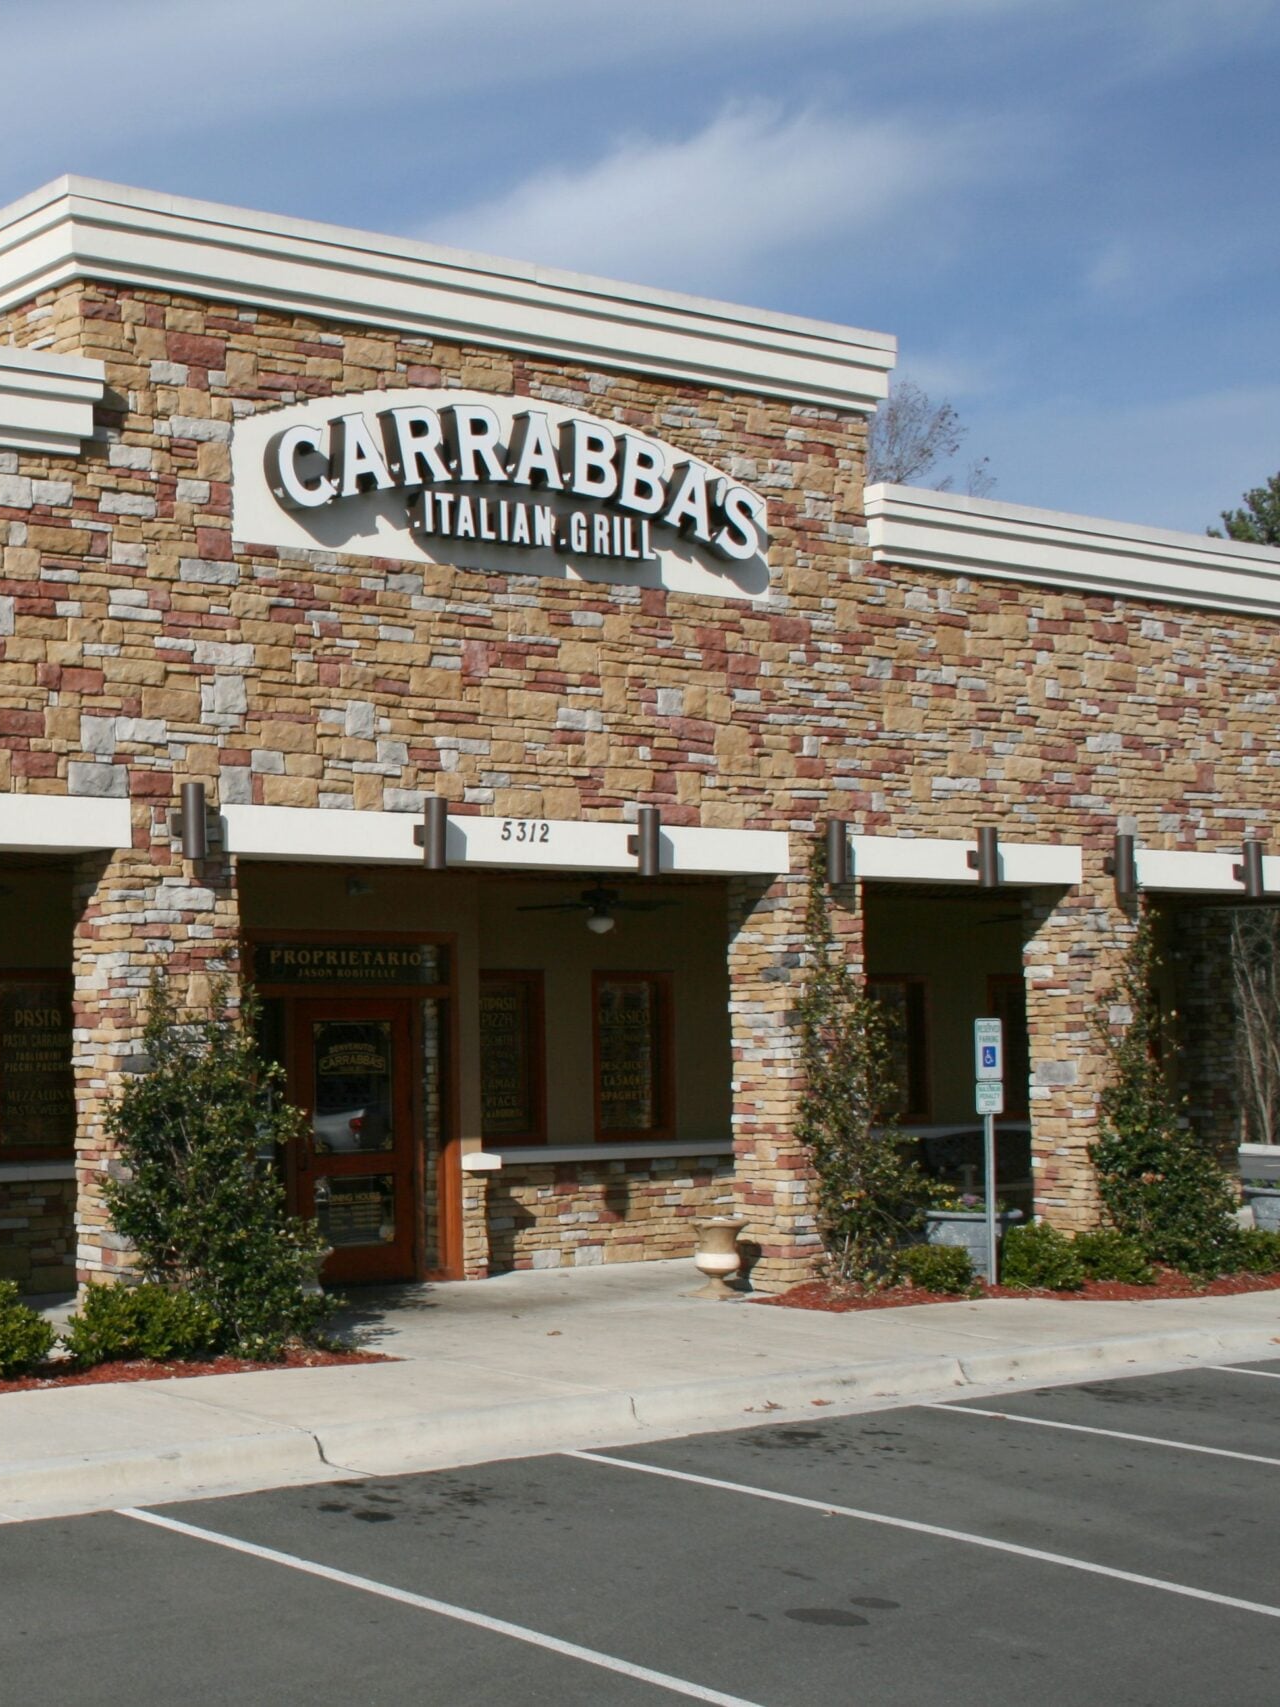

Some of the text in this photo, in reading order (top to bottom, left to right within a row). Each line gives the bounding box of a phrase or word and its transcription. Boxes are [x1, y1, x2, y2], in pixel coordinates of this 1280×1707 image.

[265, 404, 764, 561] CARRABBA'S
[424, 490, 656, 560] ITALIAN GRILL
[501, 821, 549, 843] 5312
[270, 949, 422, 966] PROPRIETARIO
[14, 1008, 62, 1027] PASTA
